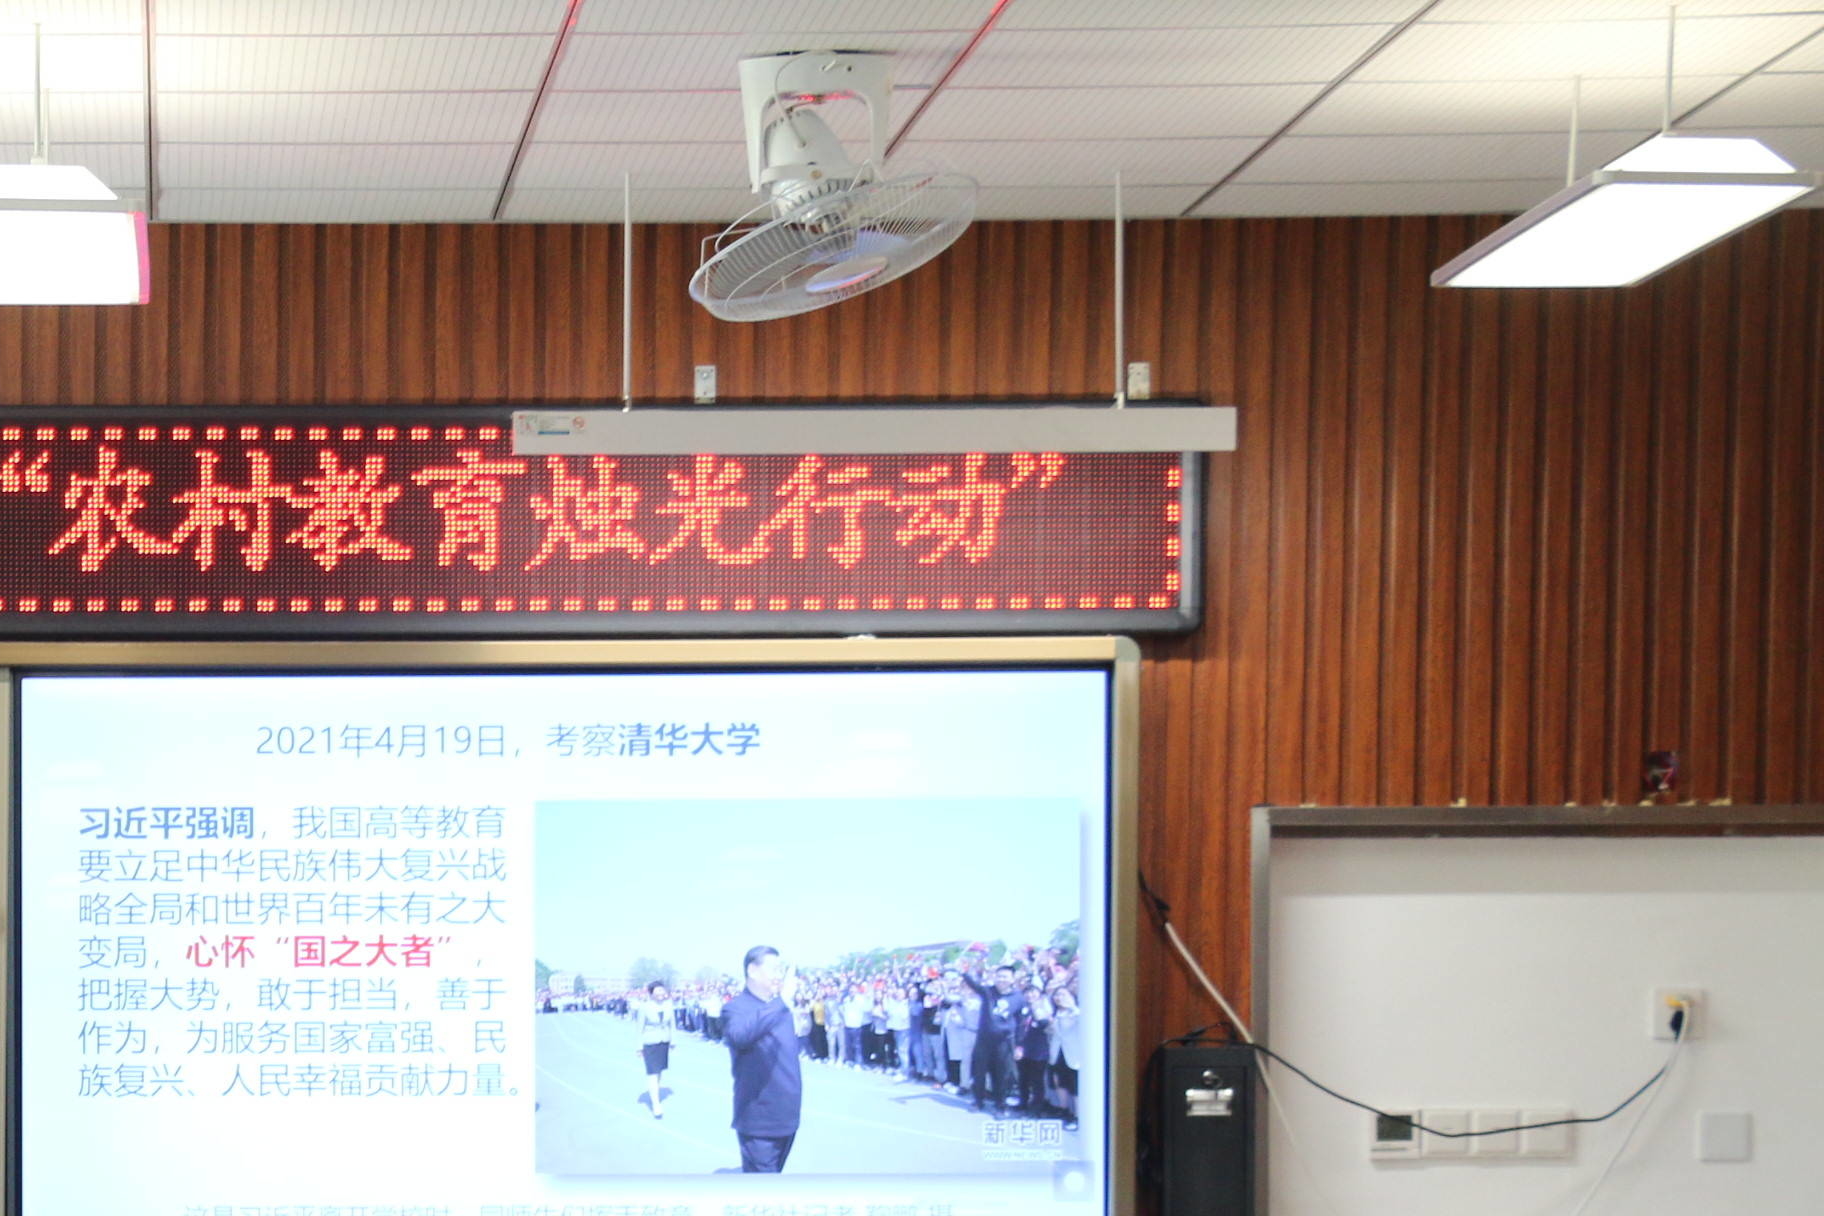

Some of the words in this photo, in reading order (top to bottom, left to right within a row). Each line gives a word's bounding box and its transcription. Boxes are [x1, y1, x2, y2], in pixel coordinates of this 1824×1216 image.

[255, 721, 762, 759] 2021年4月19日，考察清华大学
[78, 804, 507, 840] 习近平强调，我国高等教育
[78, 848, 509, 883] 要立足中华民族伟大复兴战
[78, 890, 508, 926] 略全局和世界百年未有之大
[78, 976, 508, 1012] 把握大势，敢于担当，善于
[78, 1019, 507, 1056] 作为，为服务国家富强、民
[78, 1062, 519, 1098] 族复兴、人民幸福贡献力量。
[983, 1121, 1062, 1145] 新华网
